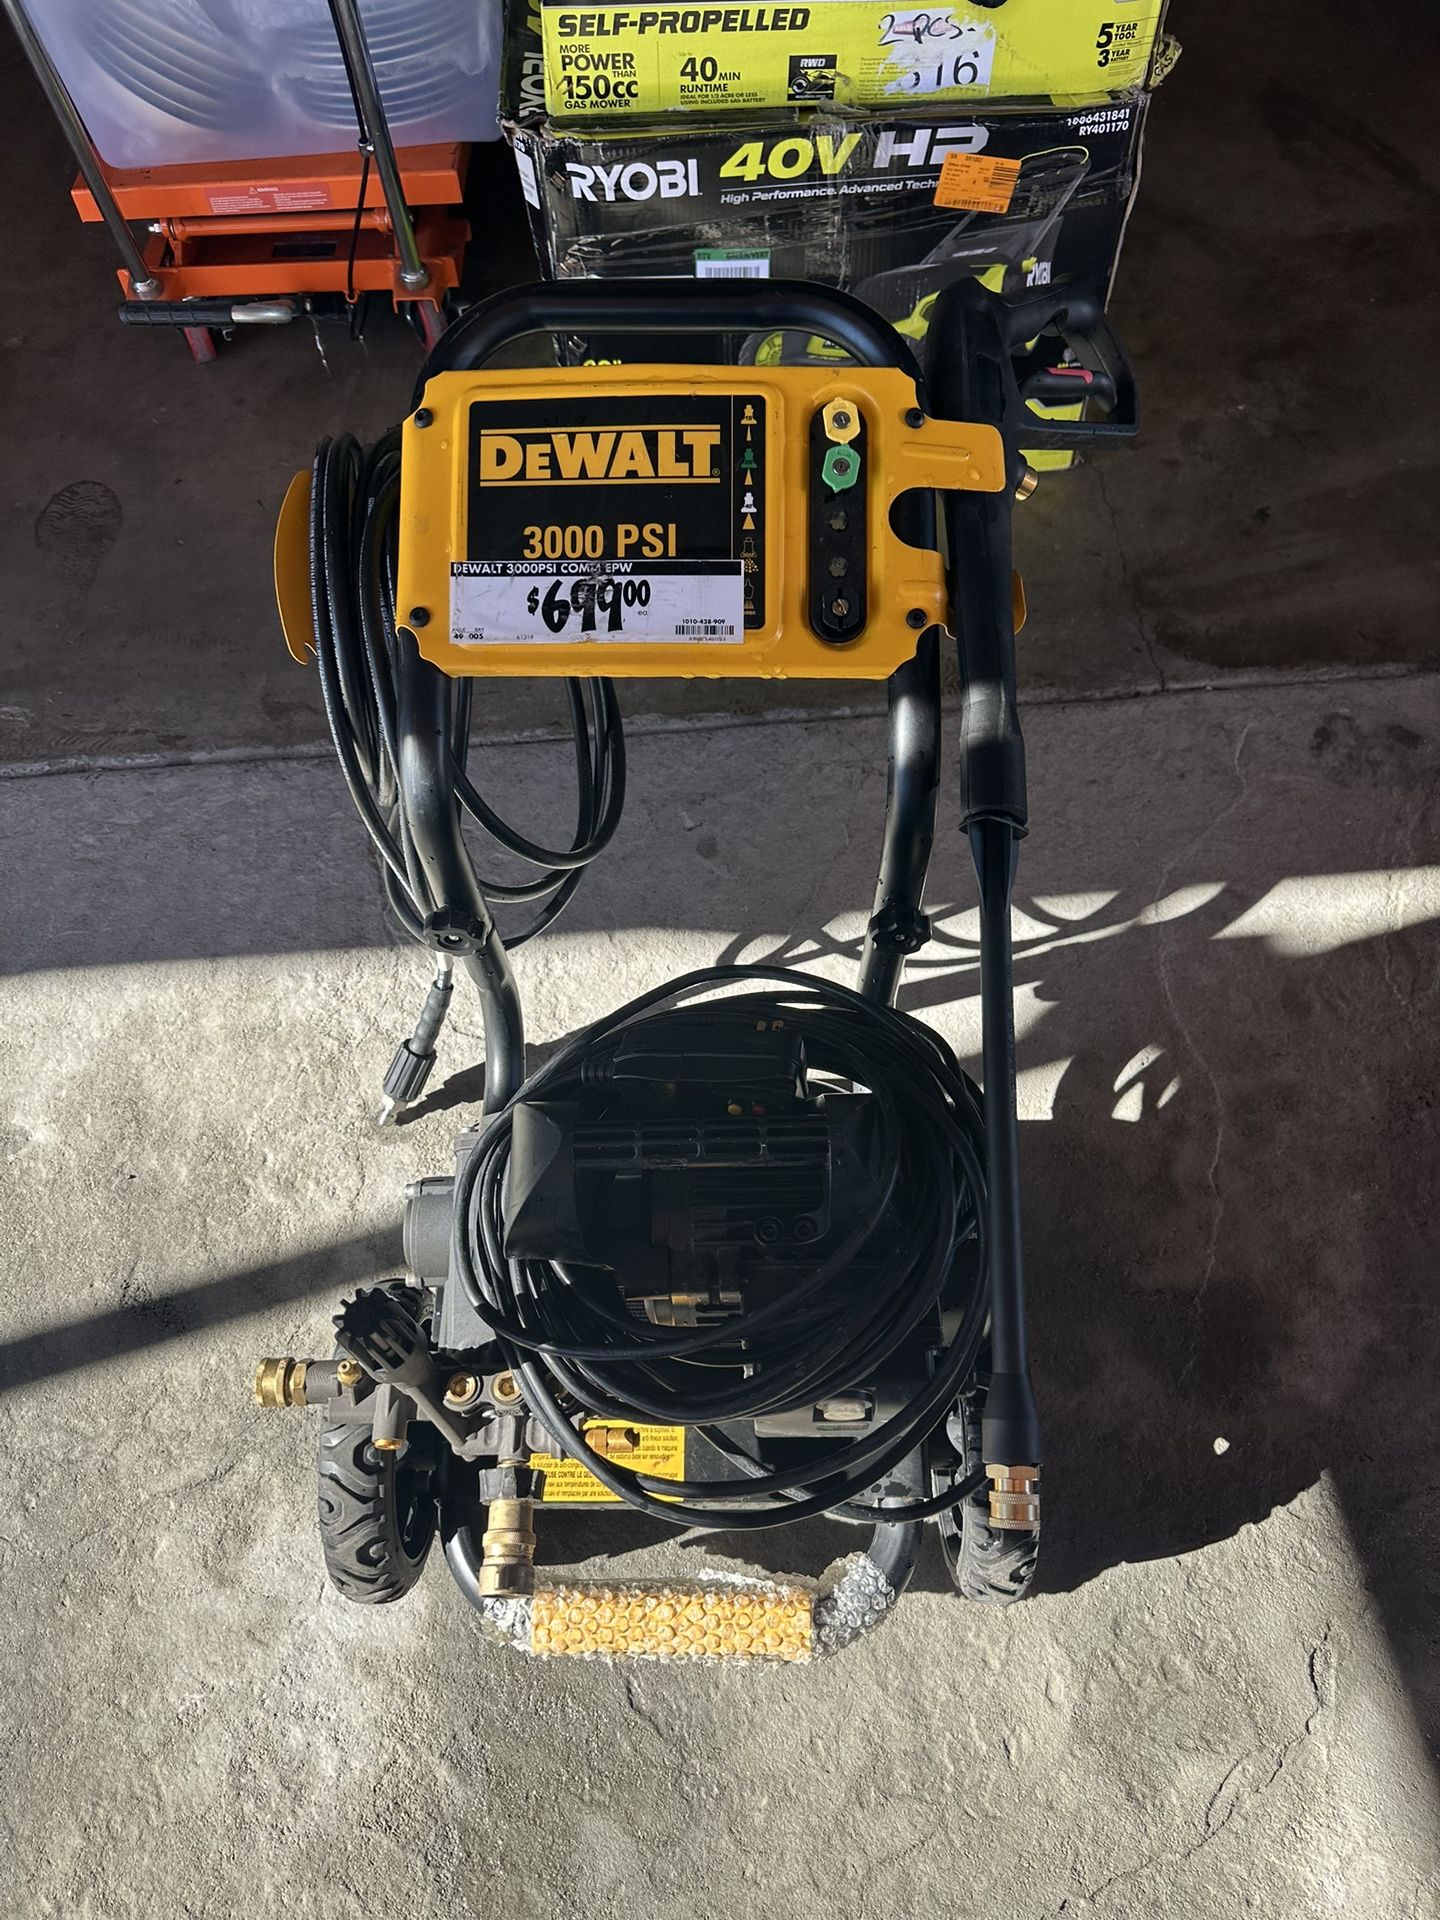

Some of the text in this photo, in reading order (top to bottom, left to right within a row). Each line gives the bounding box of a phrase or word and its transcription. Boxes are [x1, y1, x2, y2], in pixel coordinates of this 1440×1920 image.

[558, 8, 811, 37] SELF-PROPELLED
[1096, 22, 1115, 49] 5
[1115, 23, 1138, 32] YEAR
[1114, 31, 1136, 40] TOOL
[560, 44, 591, 54] MORE
[561, 53, 636, 71] POWER
[800, 58, 826, 68] RWD
[1097, 49, 1130, 68] 3 YEAR
[612, 70, 637, 78] THAN
[680, 56, 741, 82] 40 MIN
[562, 75, 639, 99] 150cc
[680, 83, 729, 93] RUNTIME
[565, 99, 631, 109] GAS MOWER
[1079, 121, 1129, 136] RY401170
[719, 132, 863, 181] 40V
[566, 158, 699, 202] RYOBI
[721, 193, 749, 205] High
[839, 181, 903, 195] Advanced
[523, 523, 676, 559] 3000 PSI
[453, 563, 502, 574] DEWALT
[506, 563, 557, 574] 3000PSI
[605, 562, 633, 573] EPW
